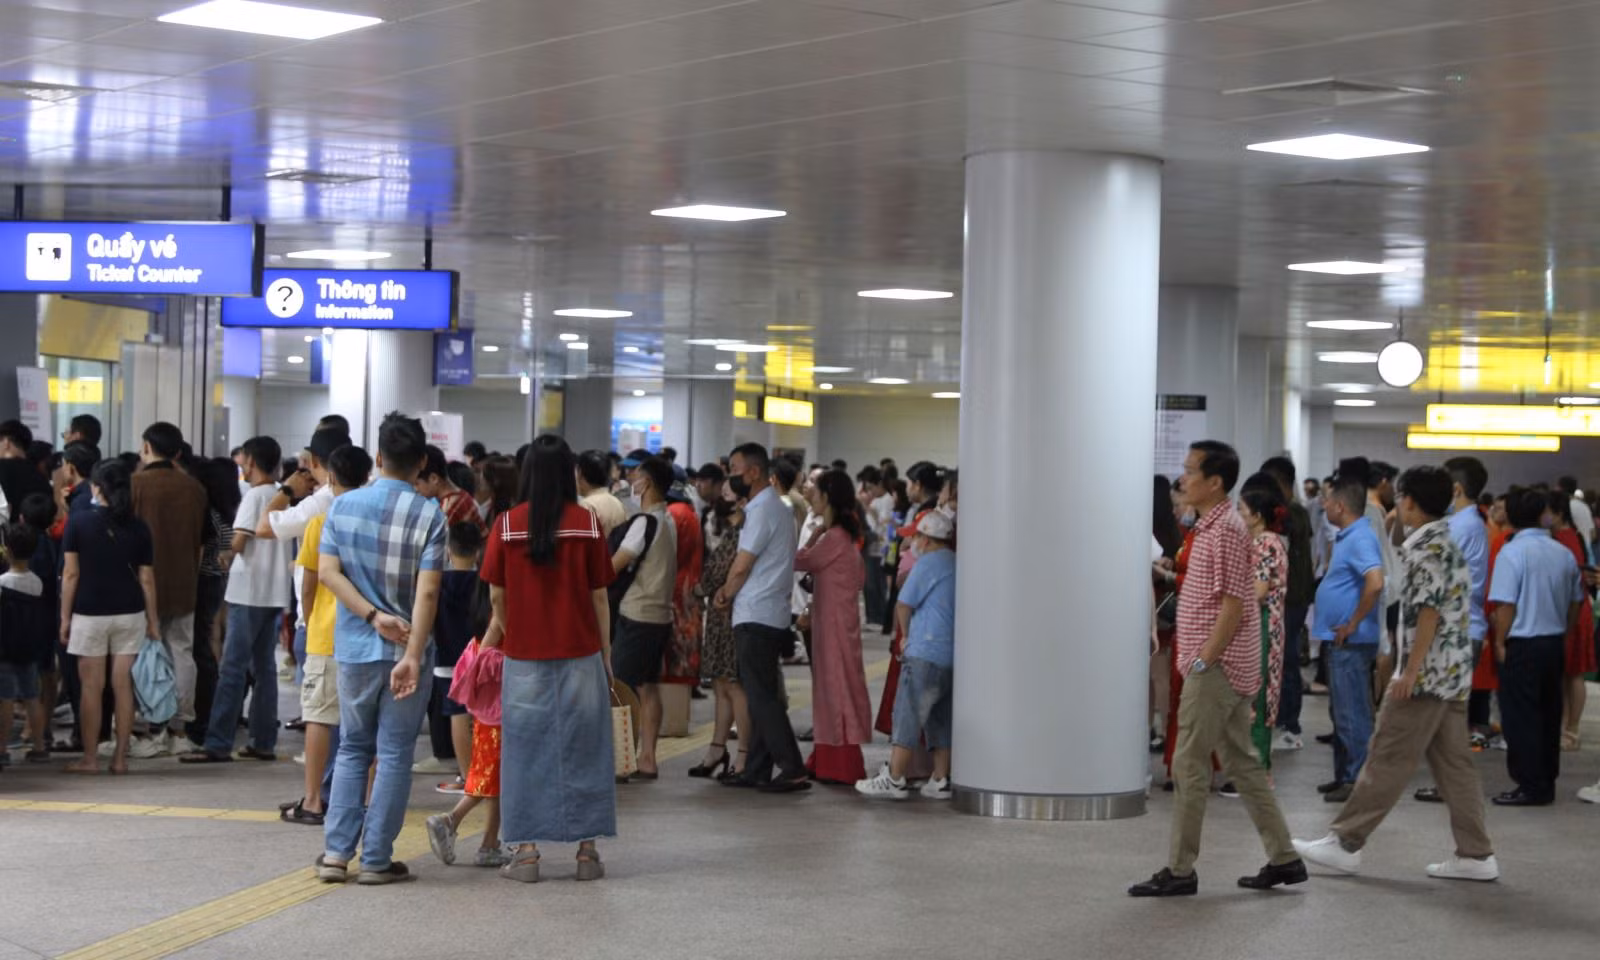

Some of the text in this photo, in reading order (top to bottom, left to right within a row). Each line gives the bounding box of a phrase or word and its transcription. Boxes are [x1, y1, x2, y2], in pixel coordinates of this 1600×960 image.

[149, 233, 178, 259] vé
[86, 263, 203, 283] Ticket Counter
[316, 278, 406, 305] Thông tin
[315, 303, 394, 320] Information
